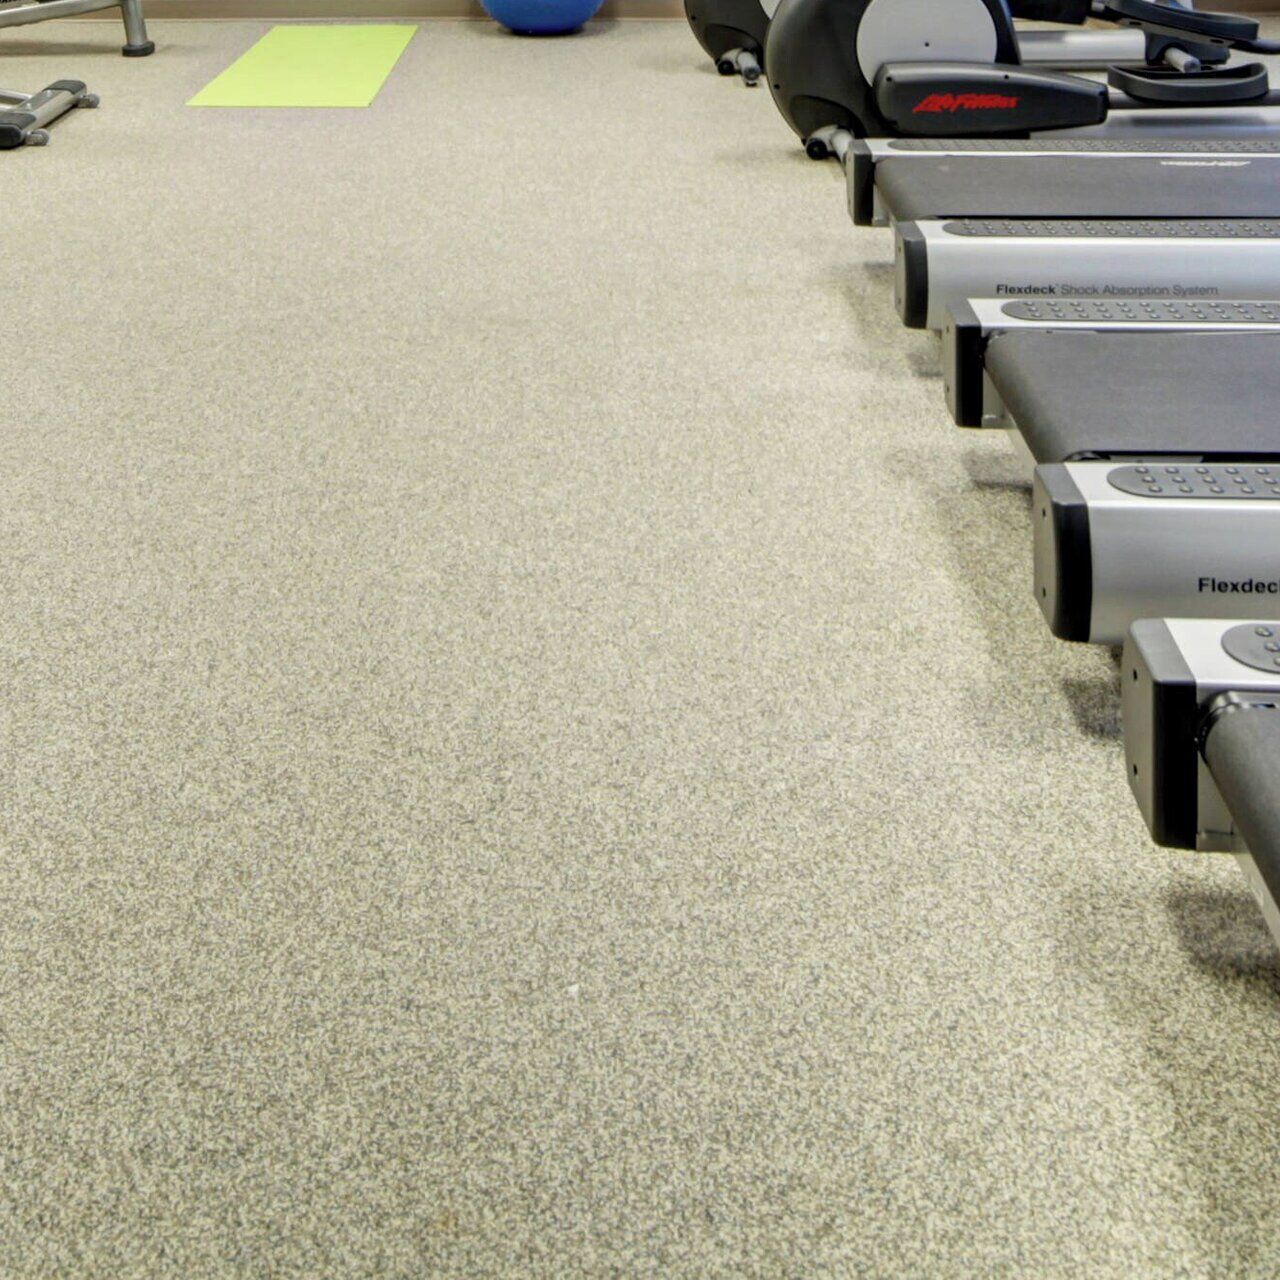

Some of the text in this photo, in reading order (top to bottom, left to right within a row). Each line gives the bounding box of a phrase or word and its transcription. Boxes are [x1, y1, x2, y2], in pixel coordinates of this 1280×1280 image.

[1061, 284, 1099, 295] Shock
[1102, 284, 1170, 297] Absorption
[1173, 285, 1218, 297] System
